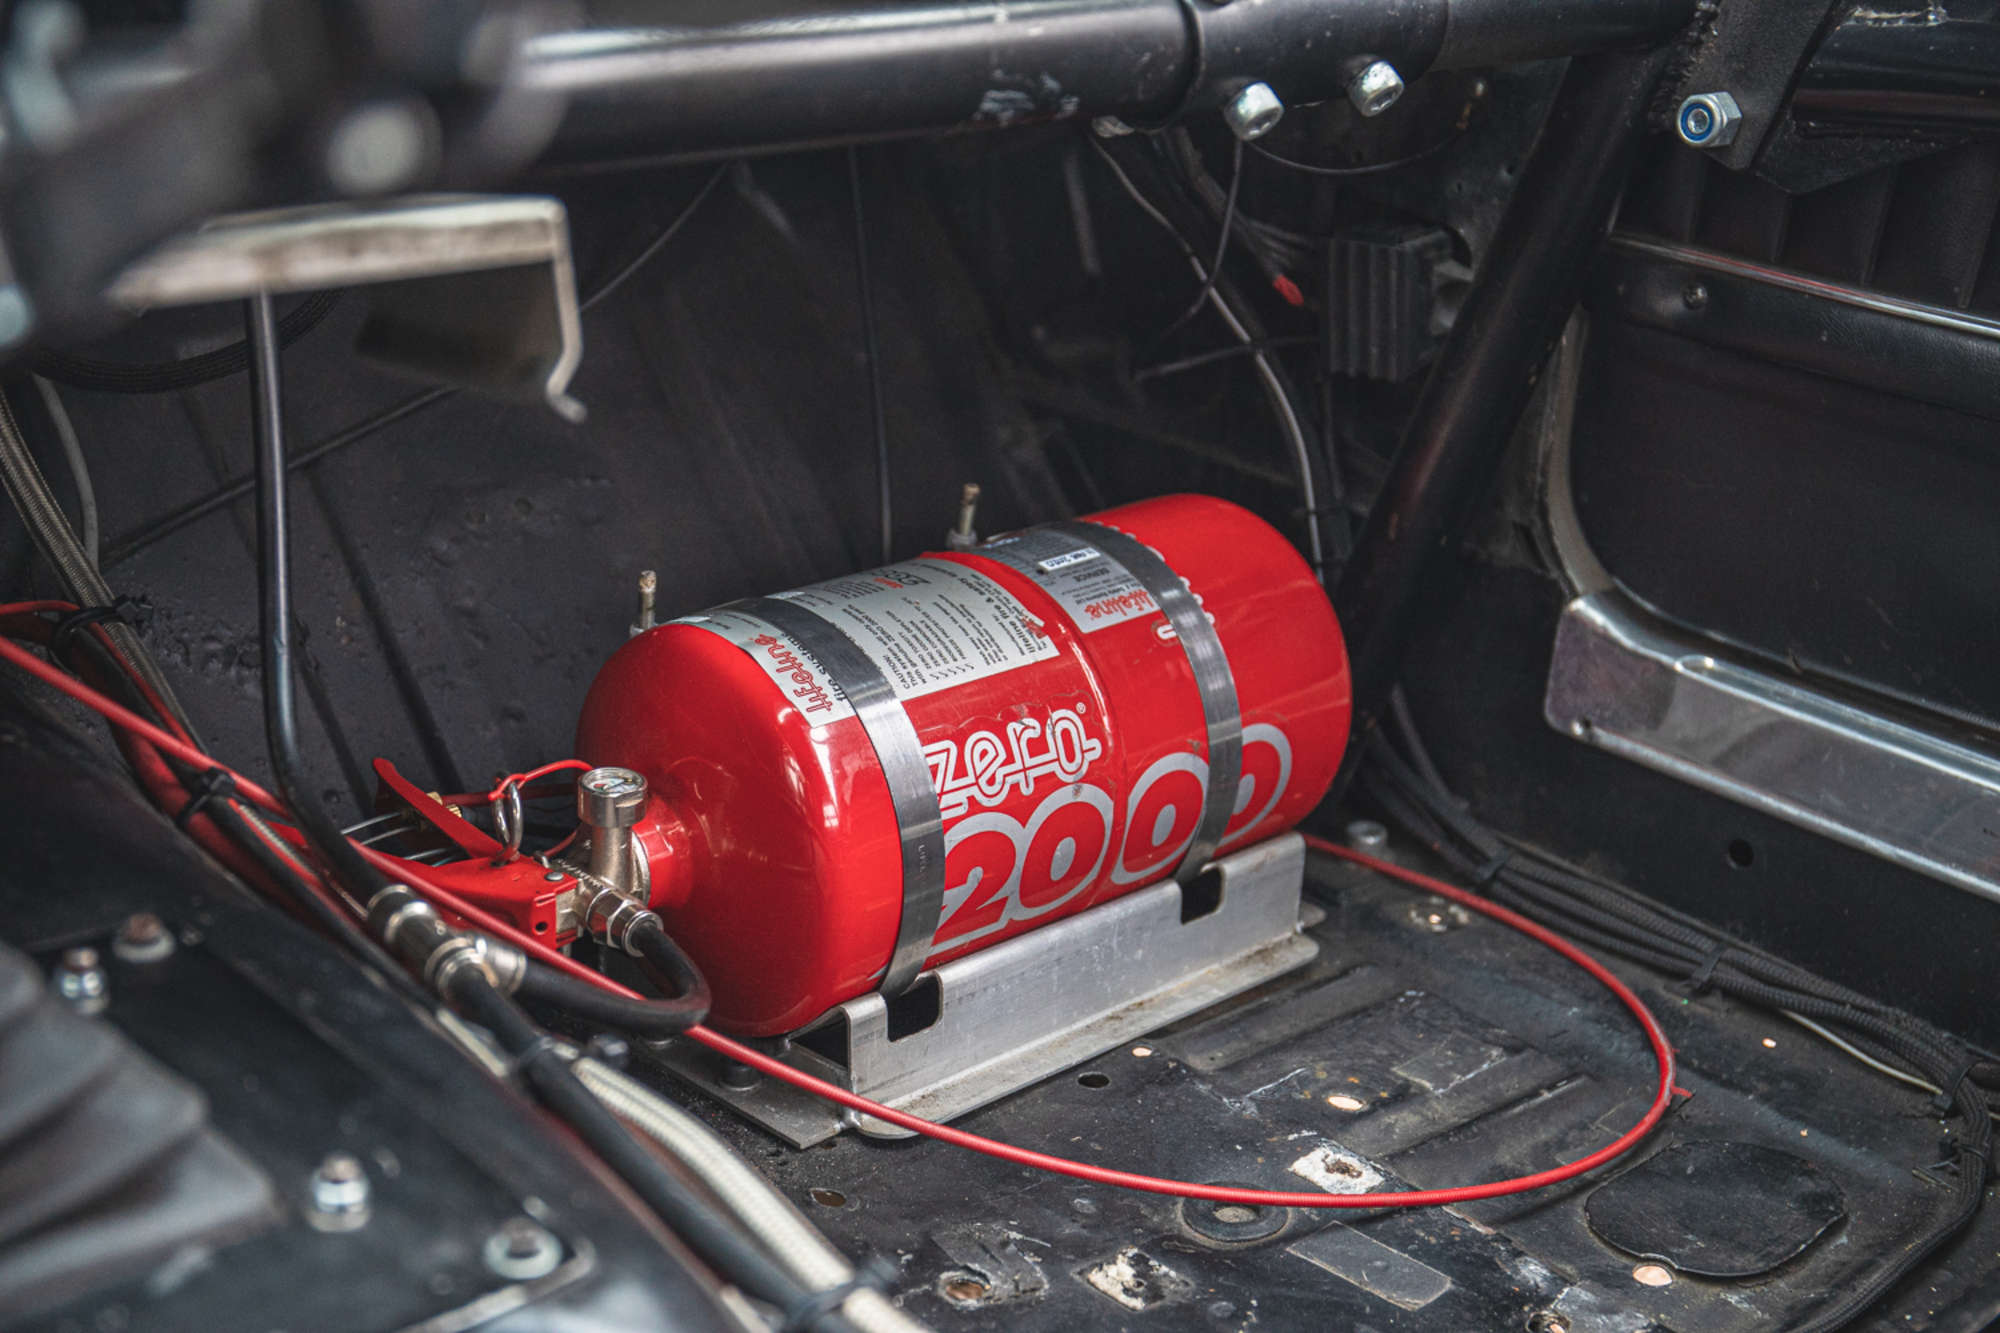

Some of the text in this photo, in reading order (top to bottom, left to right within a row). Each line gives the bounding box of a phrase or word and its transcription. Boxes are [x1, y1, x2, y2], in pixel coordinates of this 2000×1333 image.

[992, 603, 1010, 619] fire
[1084, 588, 1155, 621] lifeline
[875, 625, 895, 642] ZERO
[1007, 619, 1036, 653] lifeline
[885, 646, 908, 669] system
[892, 642, 917, 668] genuine
[917, 653, 931, 669] ZERO
[925, 651, 940, 667] ZERO
[934, 648, 949, 664] ZERO
[754, 633, 833, 714] lifeline
[882, 654, 911, 689] CAUTION!
[903, 671, 918, 686] This
[912, 668, 927, 684] with
[922, 708, 1102, 819] zero
[928, 723, 1292, 955] 2000
